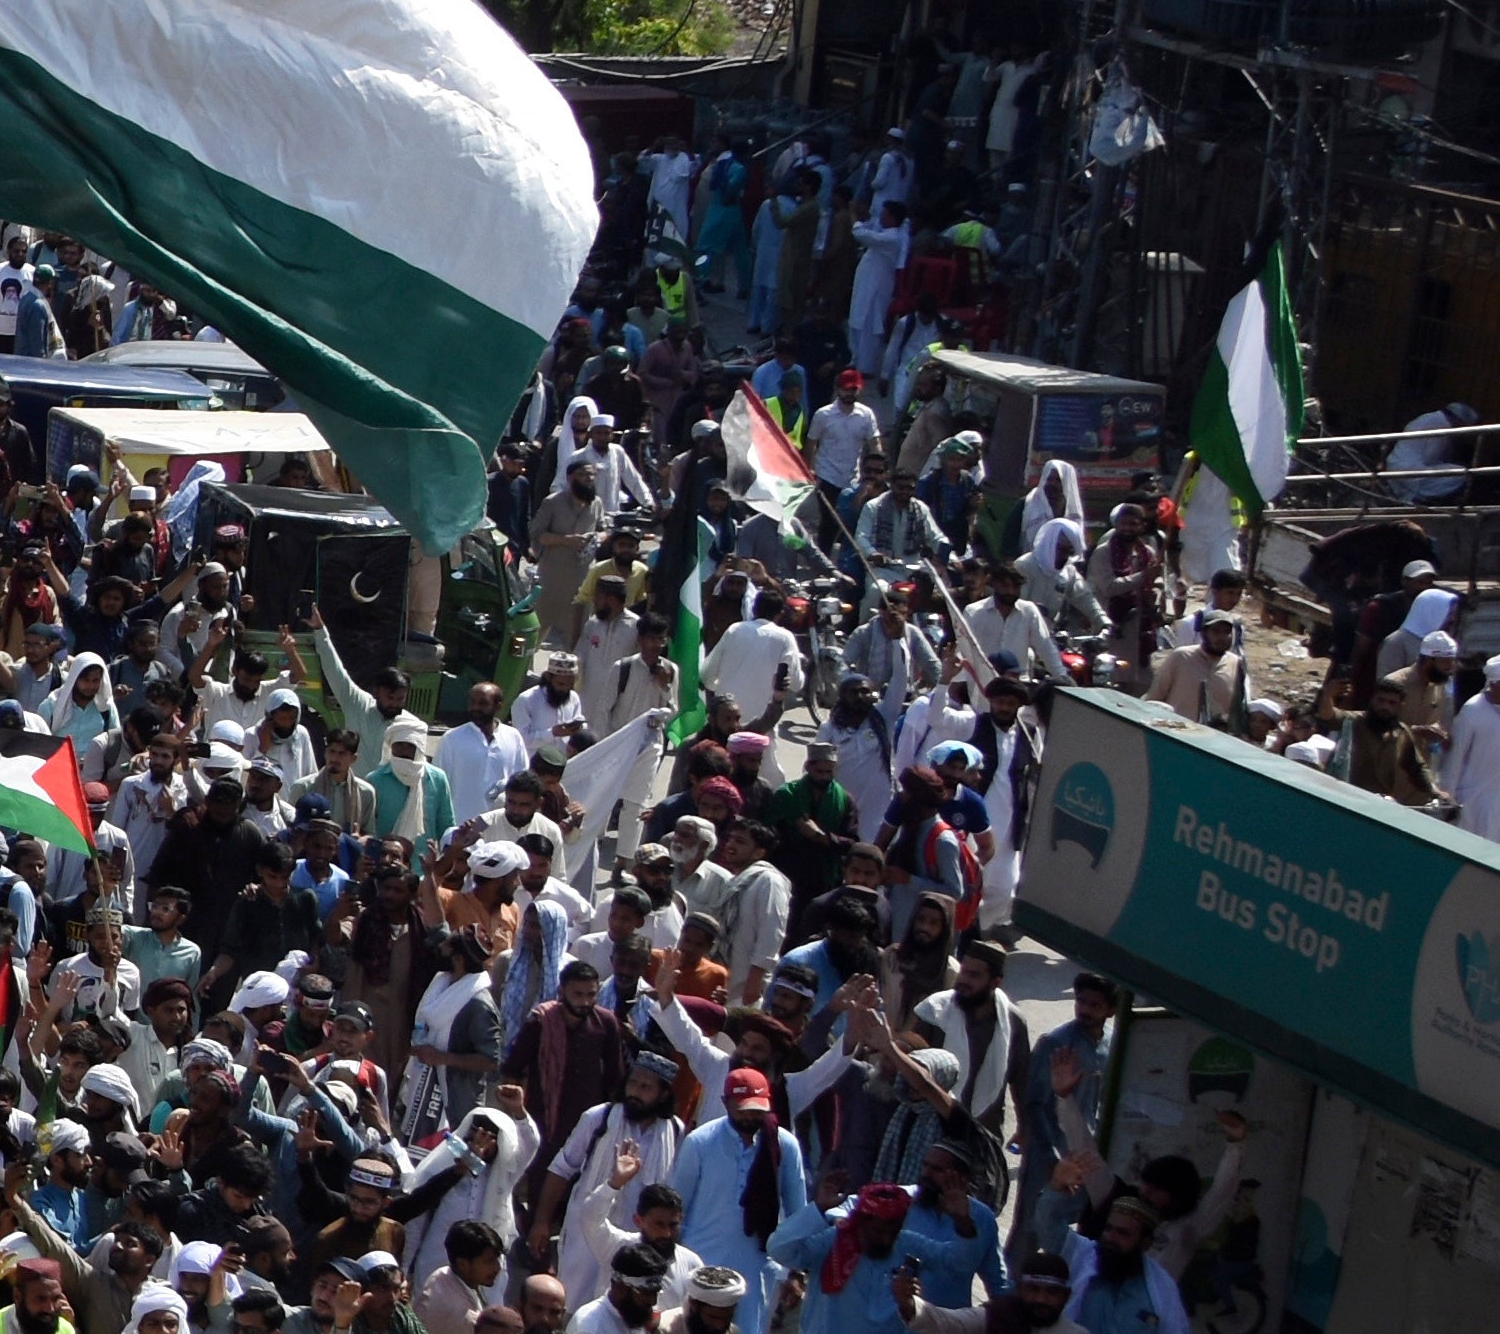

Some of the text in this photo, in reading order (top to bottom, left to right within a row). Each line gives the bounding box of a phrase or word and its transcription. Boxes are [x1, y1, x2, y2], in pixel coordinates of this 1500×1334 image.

[1173, 803, 1392, 932] Rehmanabad
[1195, 869, 1342, 974] Bus Stop
